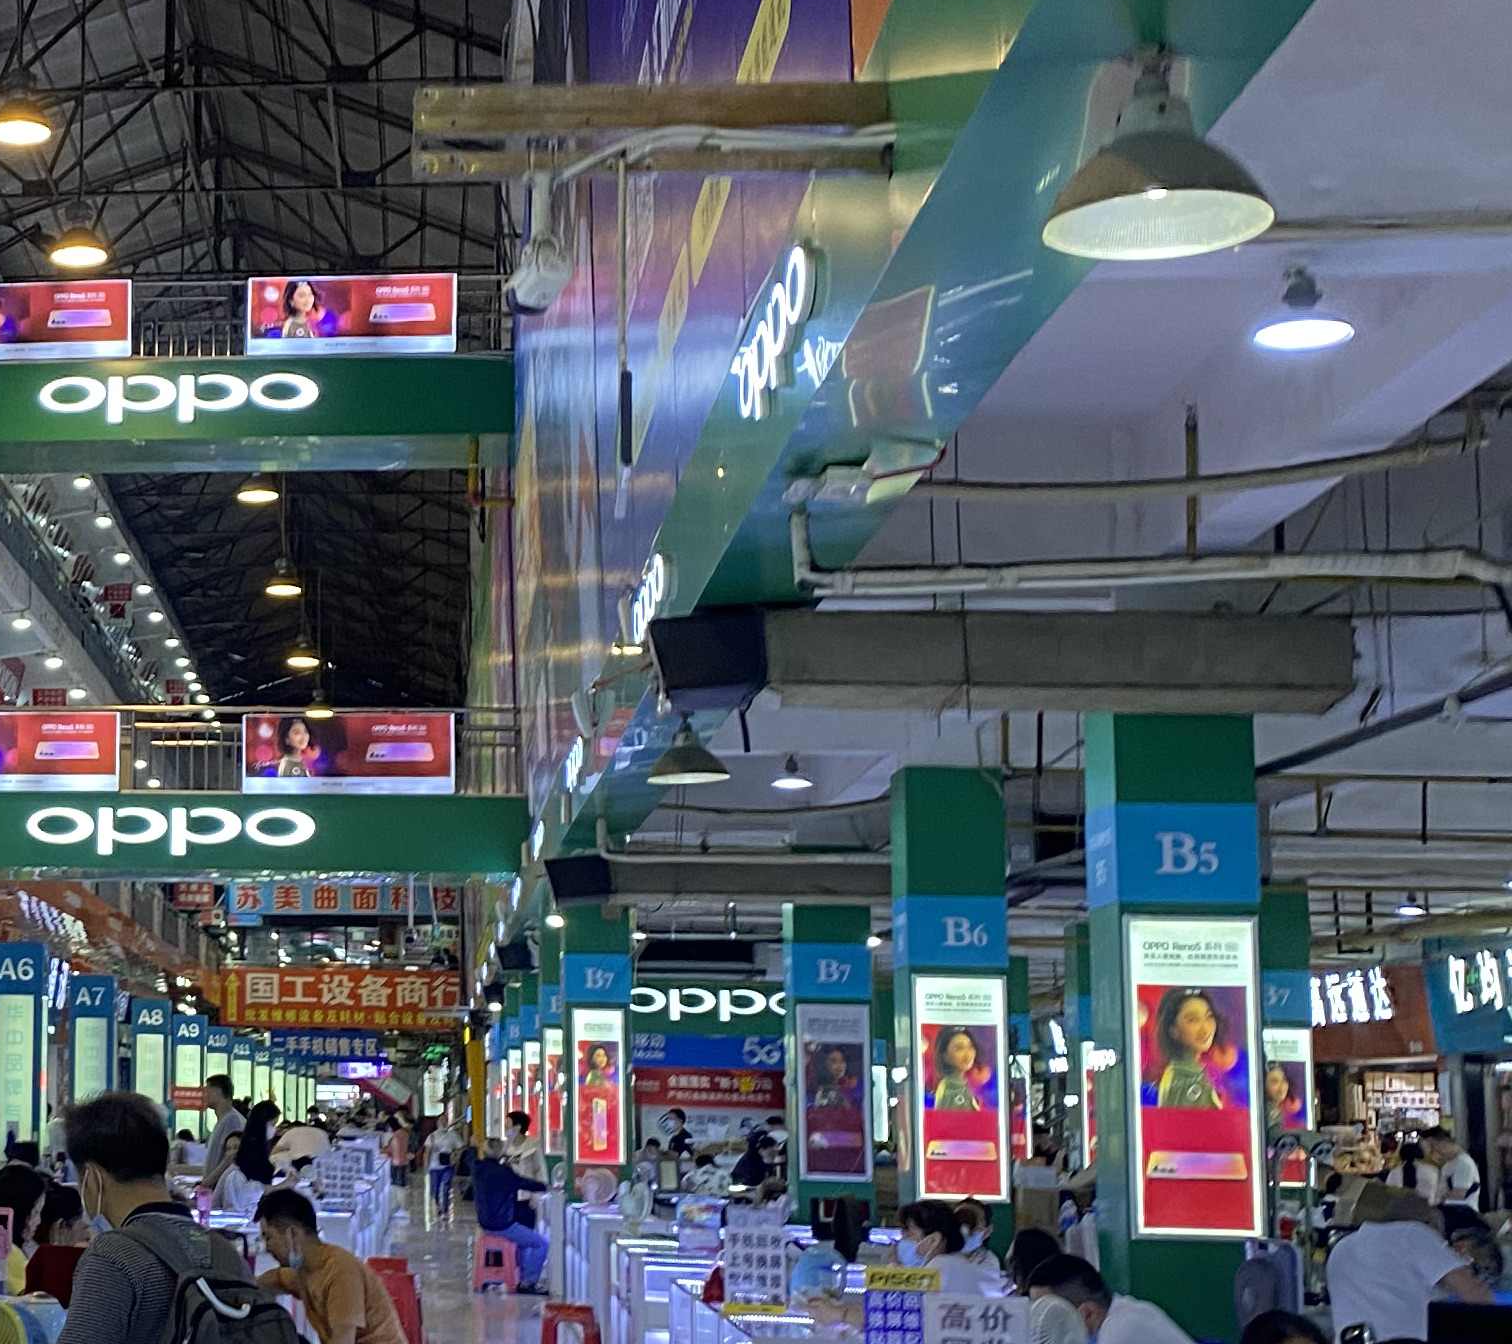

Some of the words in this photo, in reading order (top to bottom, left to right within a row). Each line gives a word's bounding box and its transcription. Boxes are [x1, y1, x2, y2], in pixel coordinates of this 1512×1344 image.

[733, 244, 806, 421] oppo
[38, 372, 320, 424] oppo
[632, 552, 664, 642] oppo
[26, 806, 317, 857] oppo
[1155, 831, 1220, 875] B5
[235, 884, 457, 913] 苏美曲面科技
[942, 916, 988, 947] B6
[1143, 941, 1168, 951] OPPO
[584, 966, 615, 992] B7
[816, 958, 852, 984] B7
[75, 987, 105, 1007] A7
[244, 973, 459, 1008] 国工设备商行
[137, 1008, 164, 1026] A8
[178, 1023, 200, 1038] A9
[207, 1033, 227, 1047] A10
[233, 1043, 251, 1055] A11
[272, 1036, 378, 1057] 二手手机销售专区
[742, 1035, 781, 1066] 5G
[939, 1302, 1012, 1332] 高价
